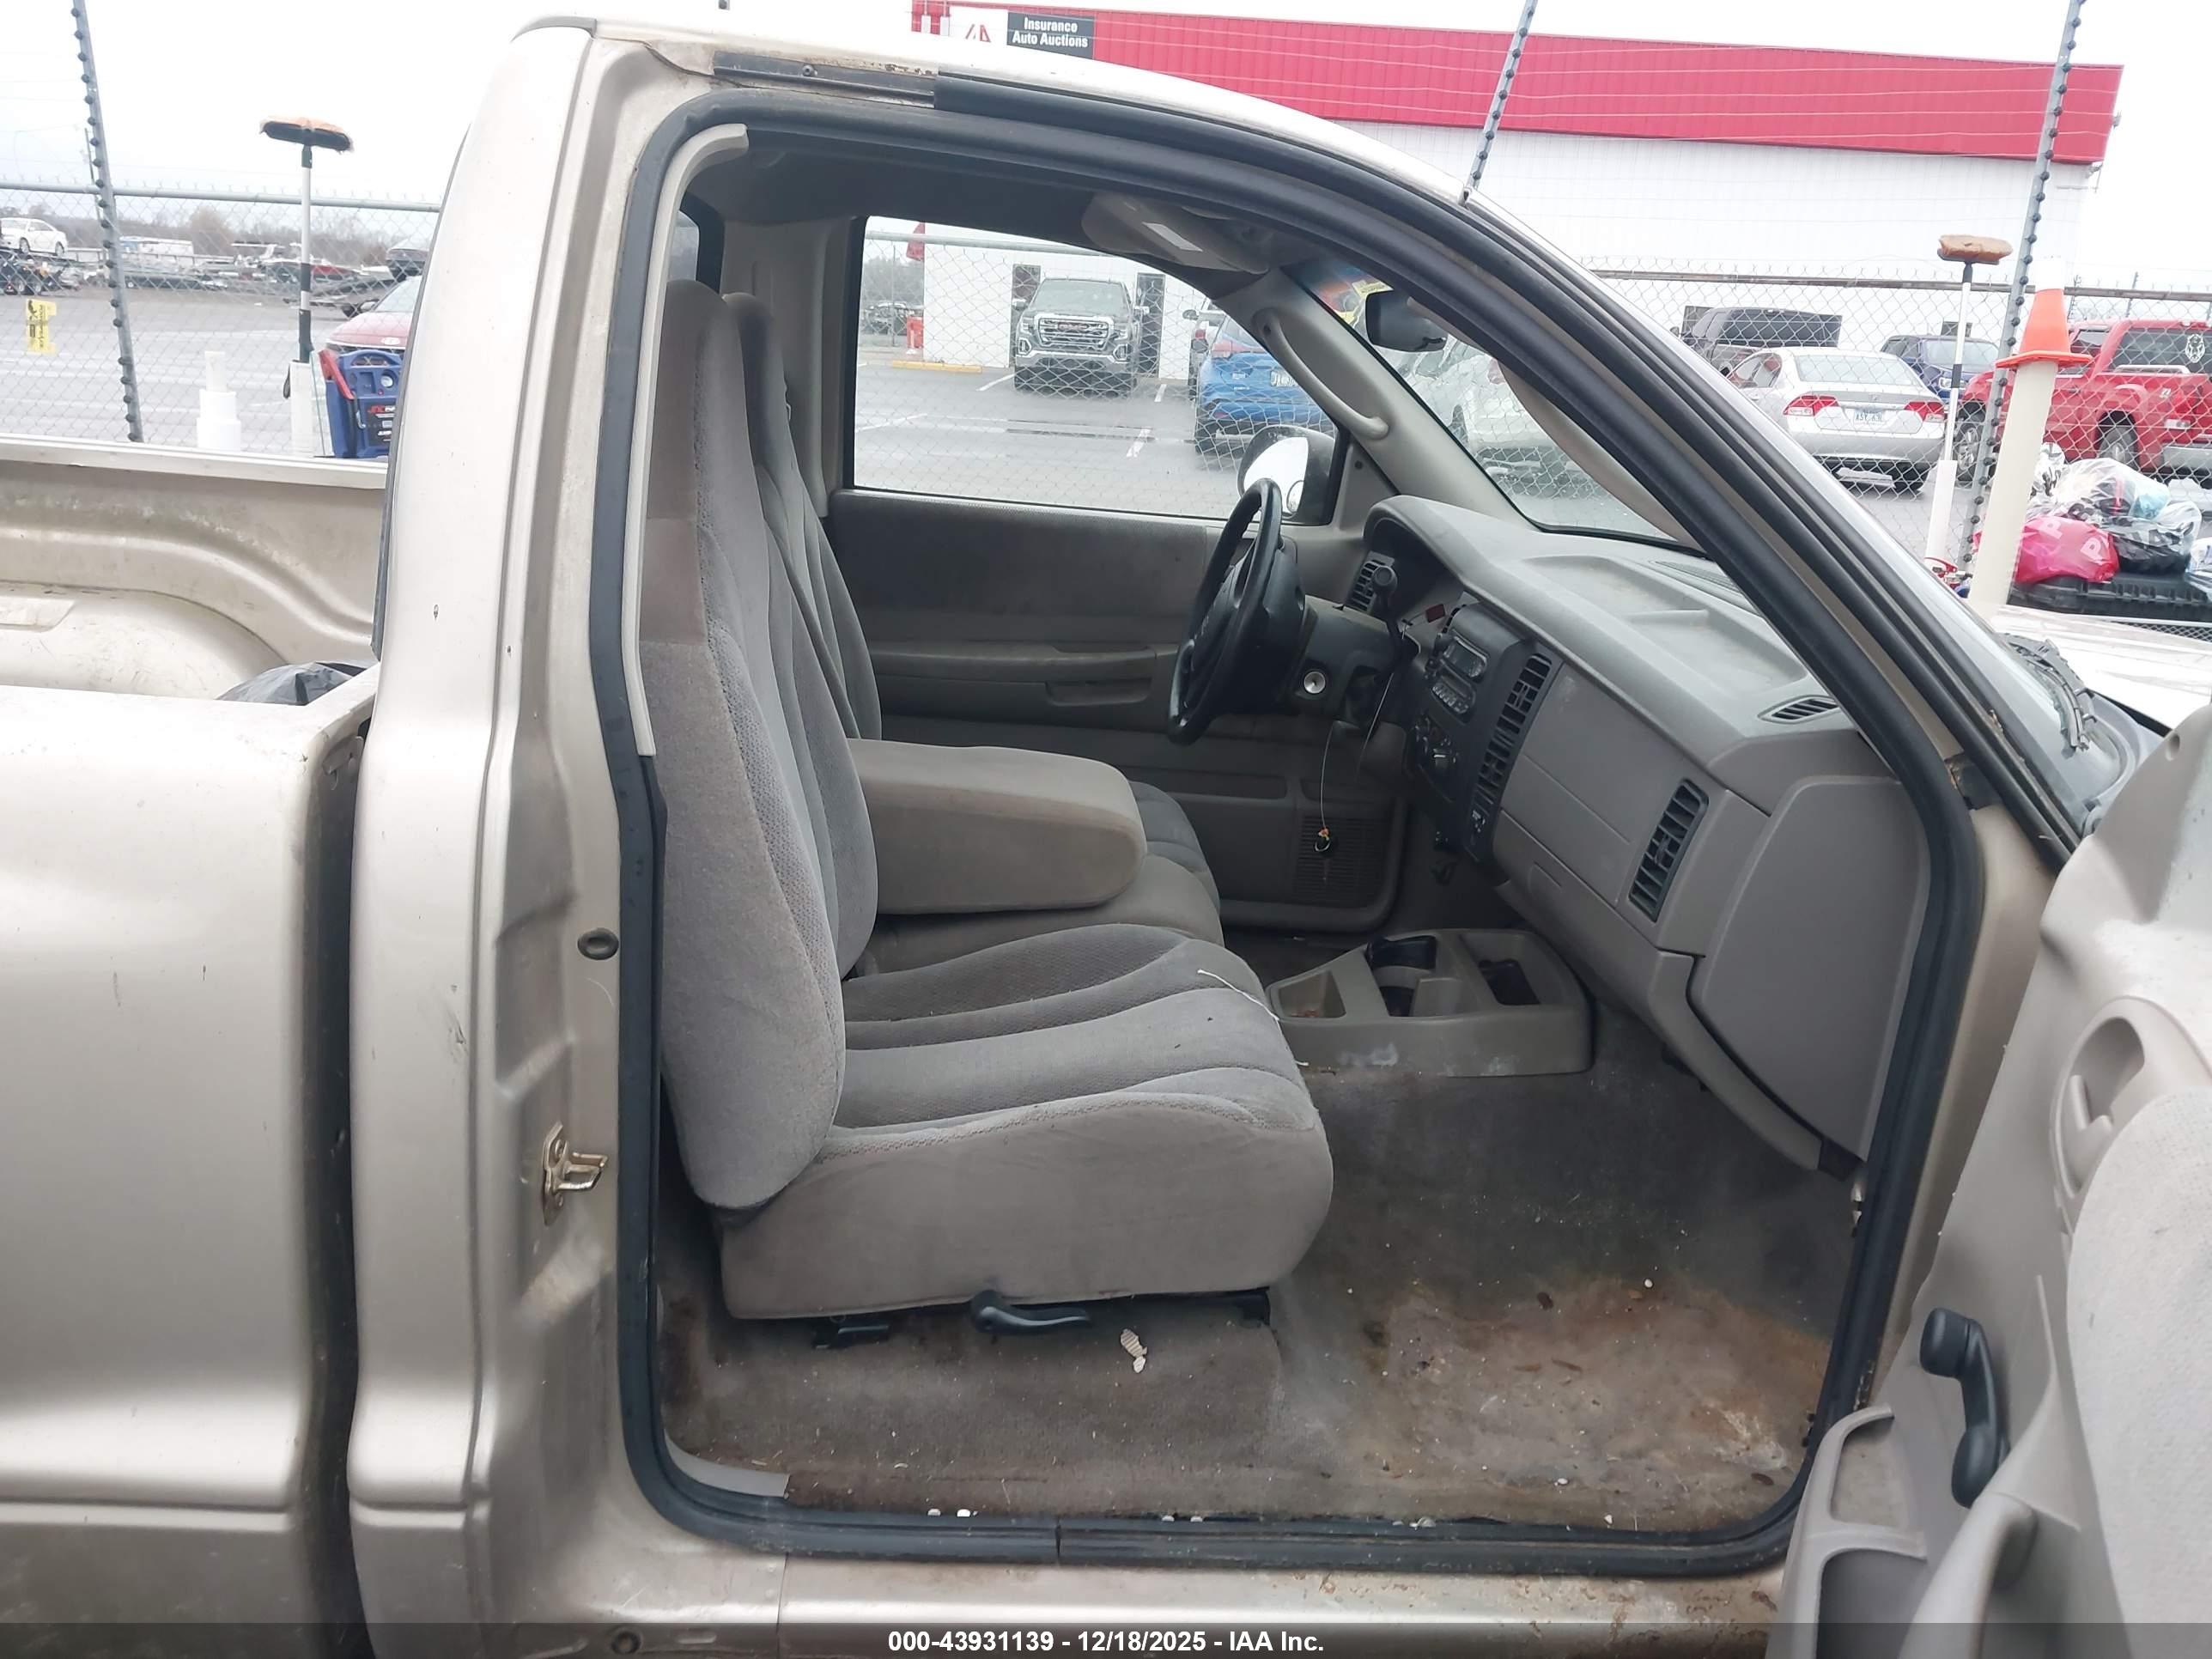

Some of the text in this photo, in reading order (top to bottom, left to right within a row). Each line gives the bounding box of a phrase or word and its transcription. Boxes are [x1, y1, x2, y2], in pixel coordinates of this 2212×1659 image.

[1024, 17, 1078, 33] Insurance
[1012, 30, 1088, 48] Auto Auctions
